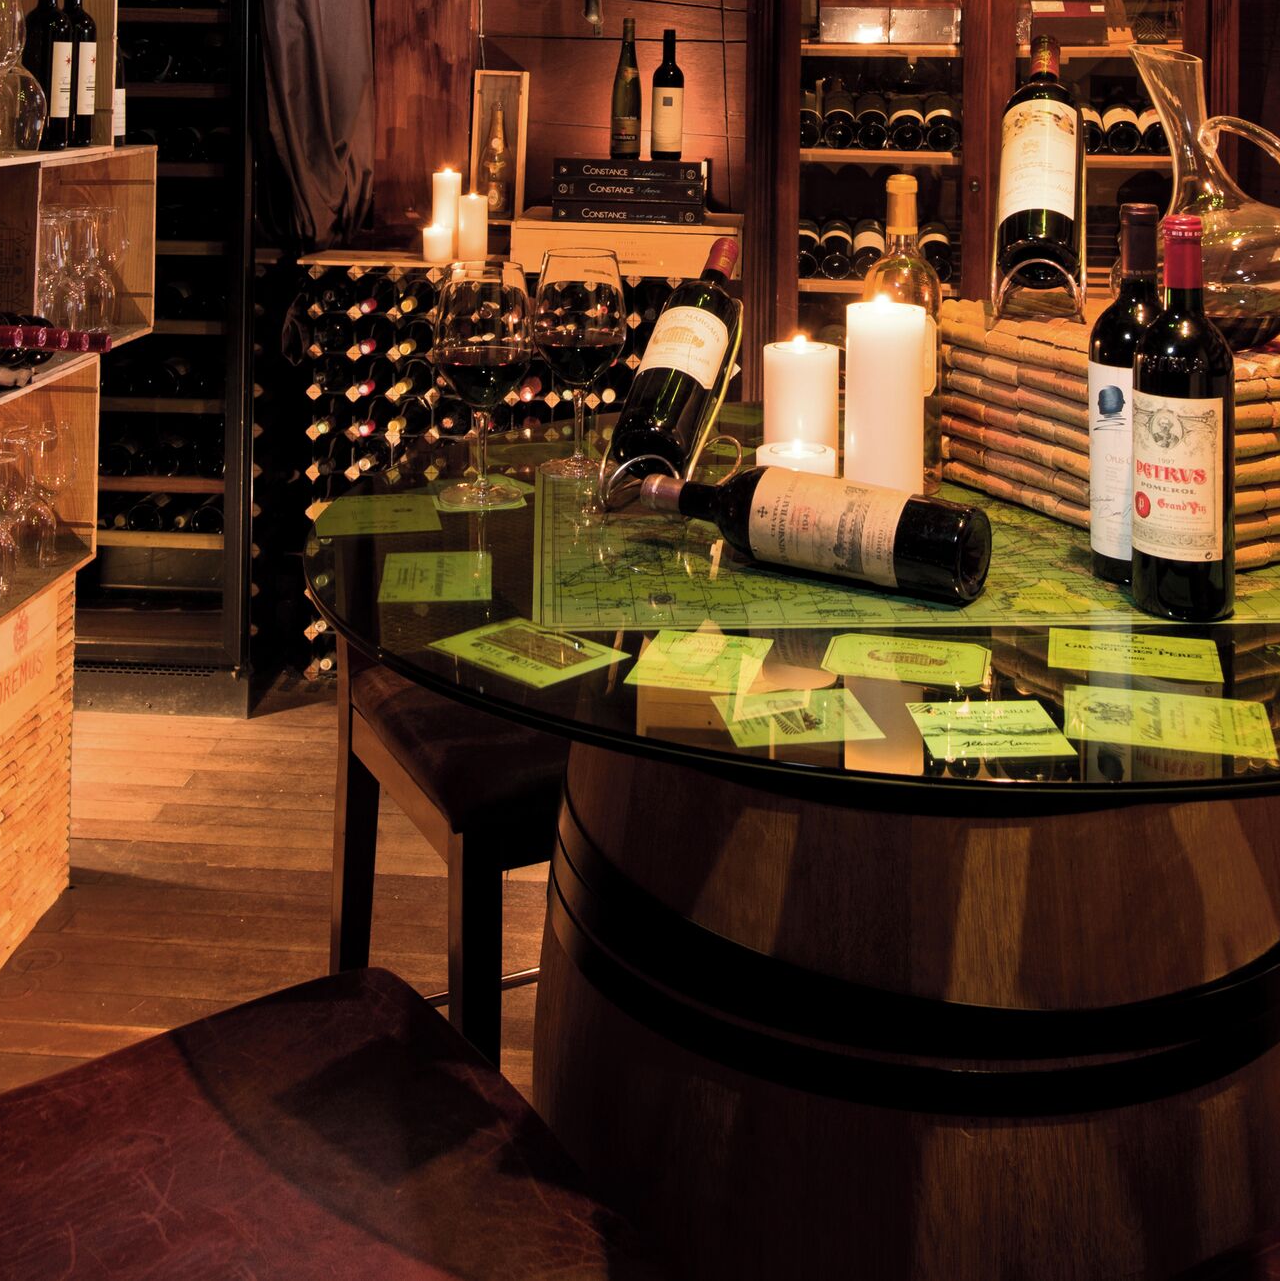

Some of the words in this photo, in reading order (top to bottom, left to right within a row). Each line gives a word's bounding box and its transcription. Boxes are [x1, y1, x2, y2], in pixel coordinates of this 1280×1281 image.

[582, 164, 628, 177] CONSTANCE
[588, 182, 635, 195] CONSTANCE
[581, 207, 627, 220] CONSTANCE
[1140, 481, 1198, 496] POMEROL
[1157, 498, 1188, 511] Grand
